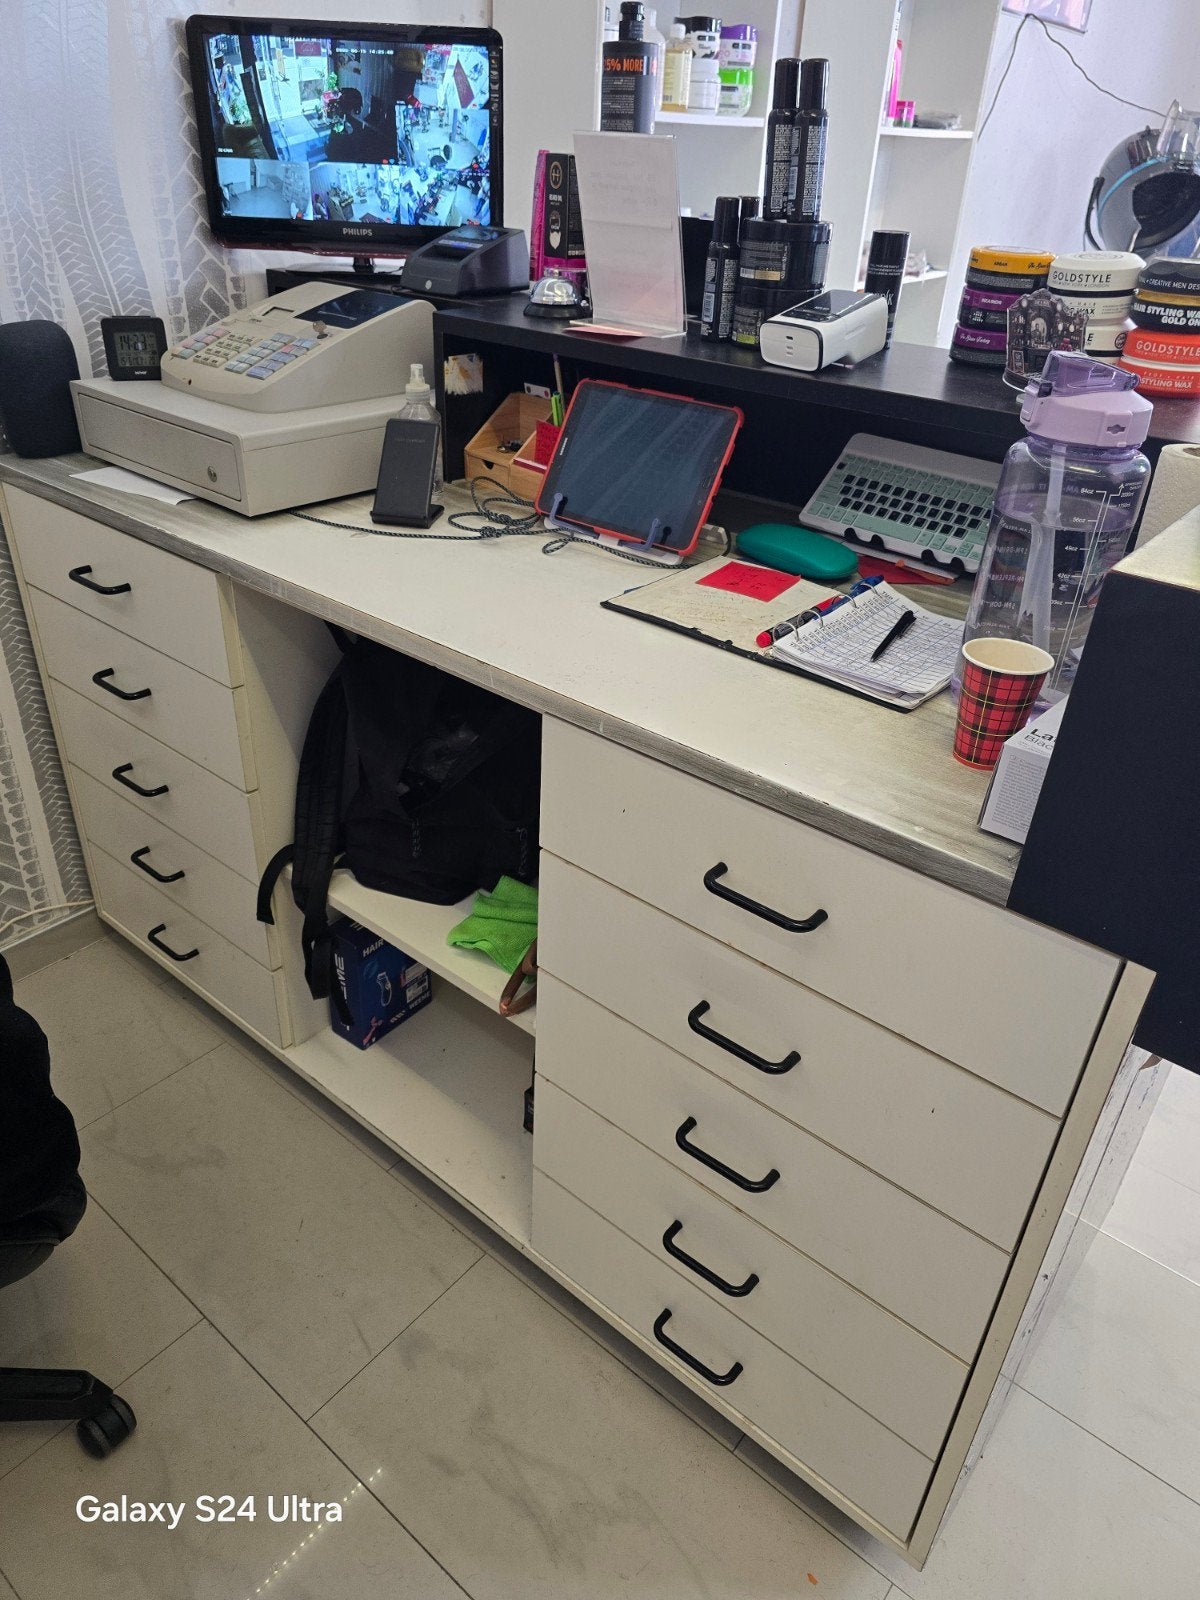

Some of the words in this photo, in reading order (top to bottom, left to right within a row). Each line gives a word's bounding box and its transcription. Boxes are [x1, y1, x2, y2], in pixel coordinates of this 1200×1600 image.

[623, 59, 644, 72] MORE
[342, 227, 373, 237] PHILIPS
[1052, 271, 1112, 284] GOLDSTYLE
[1150, 279, 1171, 288] CREATIVE
[1172, 281, 1187, 290] MEN
[1147, 305, 1185, 318] STYLING
[1161, 315, 1187, 326] GOLD
[1136, 340, 1200, 357] GOLDSTYLE
[1141, 377, 1173, 388] STYLING
[1174, 381, 1193, 389] WAX
[1030, 728, 1057, 743] La
[362, 939, 385, 958] HAIR
